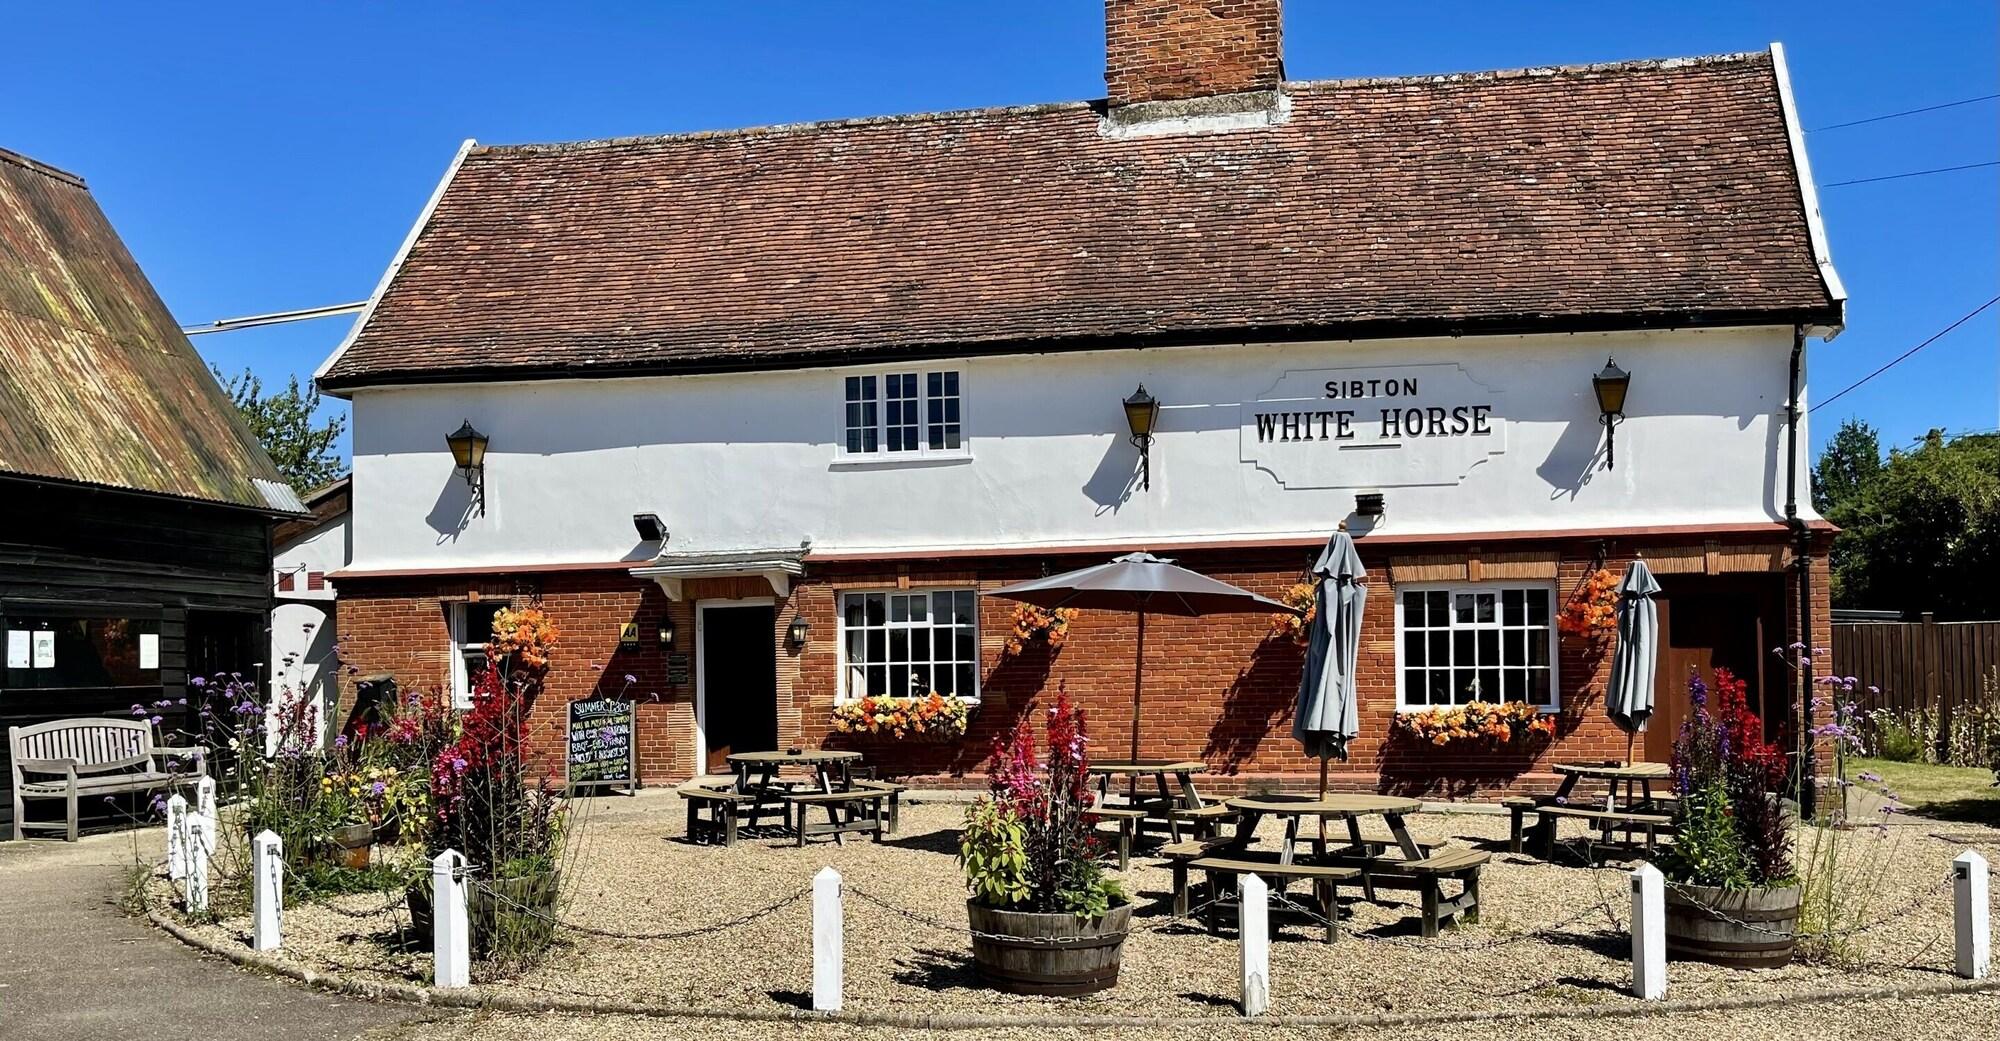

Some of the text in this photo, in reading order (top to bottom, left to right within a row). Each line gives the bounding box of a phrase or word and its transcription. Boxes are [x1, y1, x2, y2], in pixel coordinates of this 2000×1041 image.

[1325, 378, 1418, 399] SIBTON
[1255, 405, 1492, 442] WHITE HORSE
[623, 627, 636, 637] AA
[574, 701, 605, 714] SUMMER
